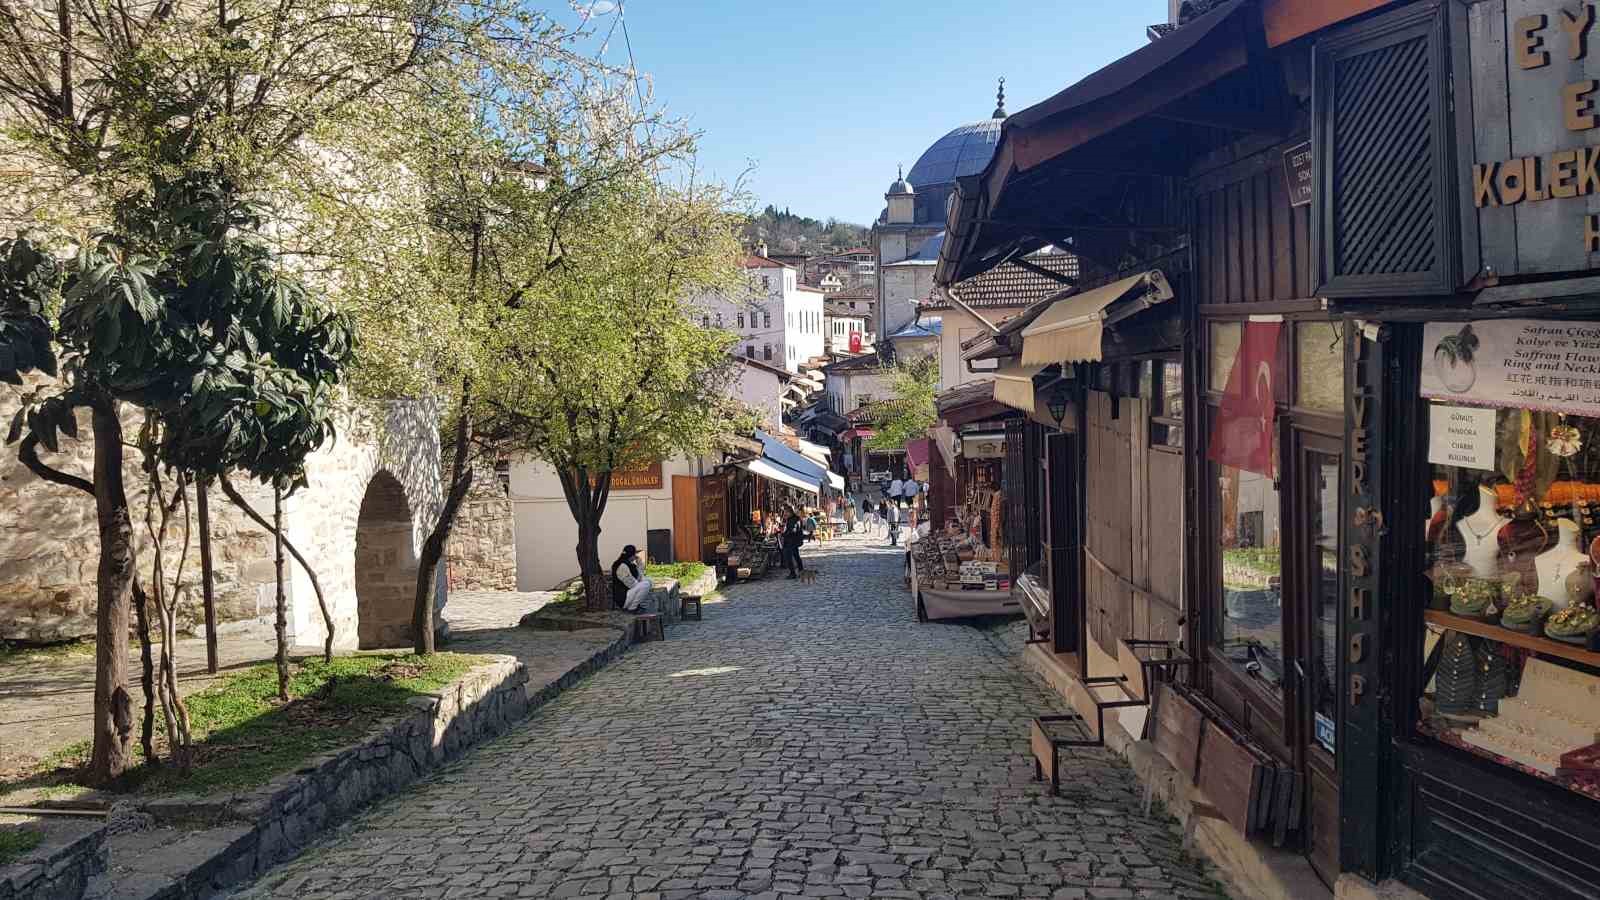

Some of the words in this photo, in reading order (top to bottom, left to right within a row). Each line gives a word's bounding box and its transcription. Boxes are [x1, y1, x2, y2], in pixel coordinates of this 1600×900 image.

[1472, 148, 1600, 208] KOLEK
[1522, 326, 1563, 335] Safran
[1516, 337, 1552, 348] Kalye
[1513, 350, 1561, 361] Saffran
[1503, 359, 1532, 371] Ring
[1535, 361, 1560, 371] and
